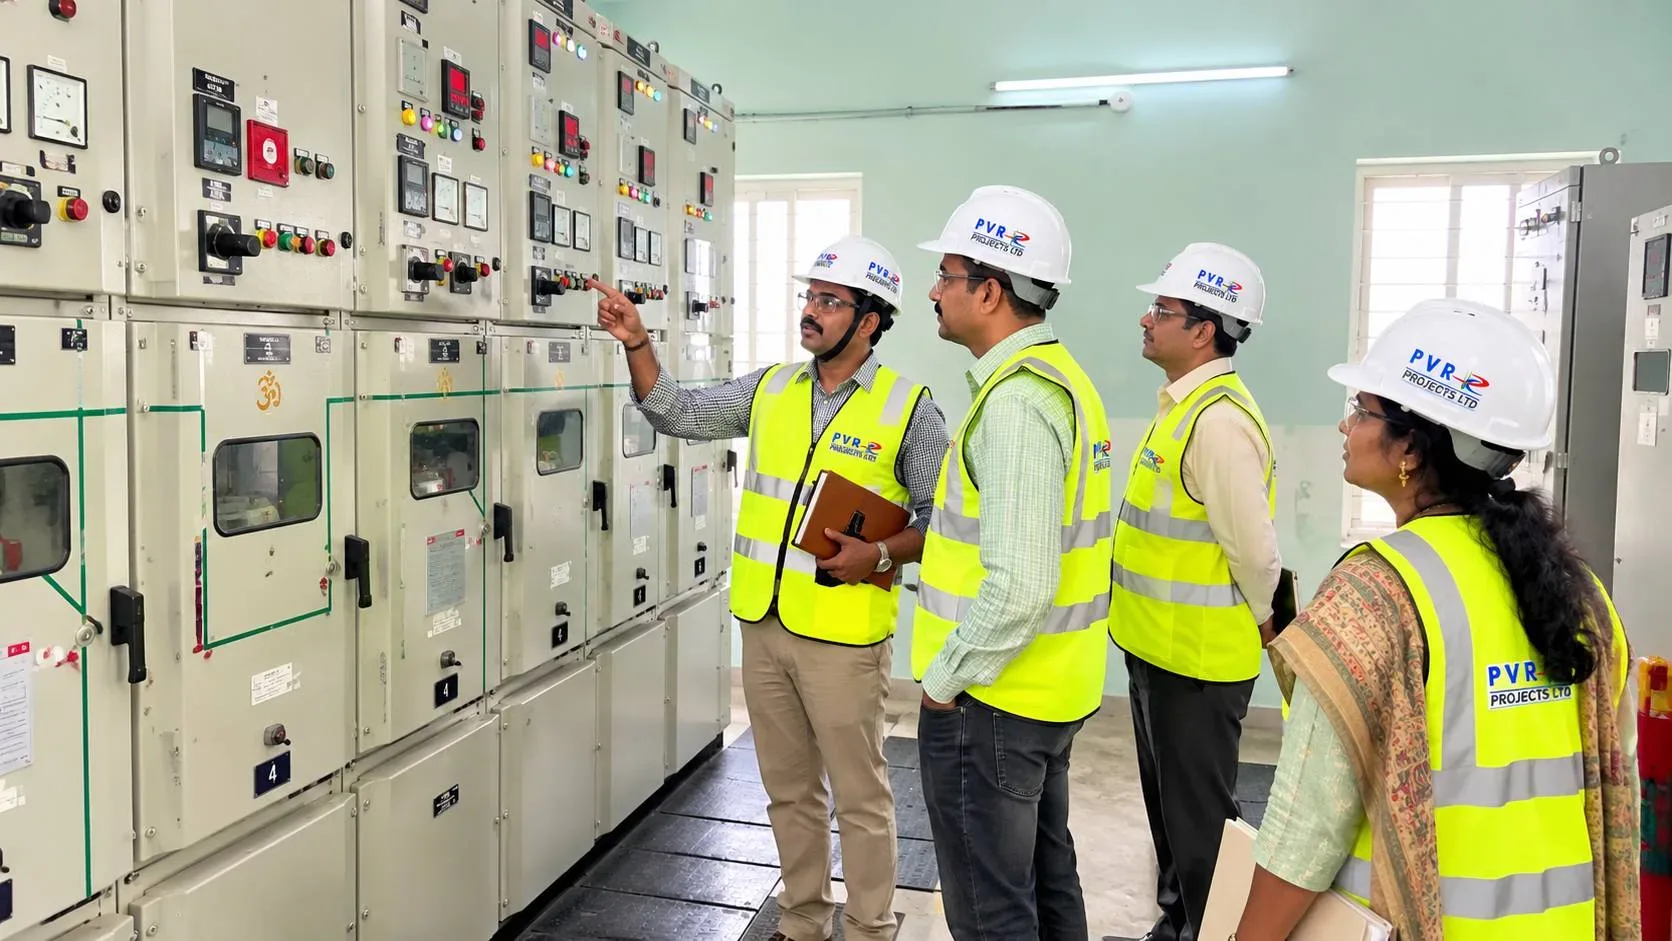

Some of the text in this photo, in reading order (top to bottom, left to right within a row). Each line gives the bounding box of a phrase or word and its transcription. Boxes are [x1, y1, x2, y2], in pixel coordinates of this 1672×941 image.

[974, 217, 1006, 239] PVR
[1197, 269, 1223, 288] PVR
[1409, 348, 1456, 381] PVR
[1402, 369, 1478, 409] PROJECTS LTD
[831, 432, 861, 448] PVR
[1487, 661, 1538, 687] PVR
[1490, 688, 1550, 707] PROJECTS
[268, 764, 278, 783] 4
